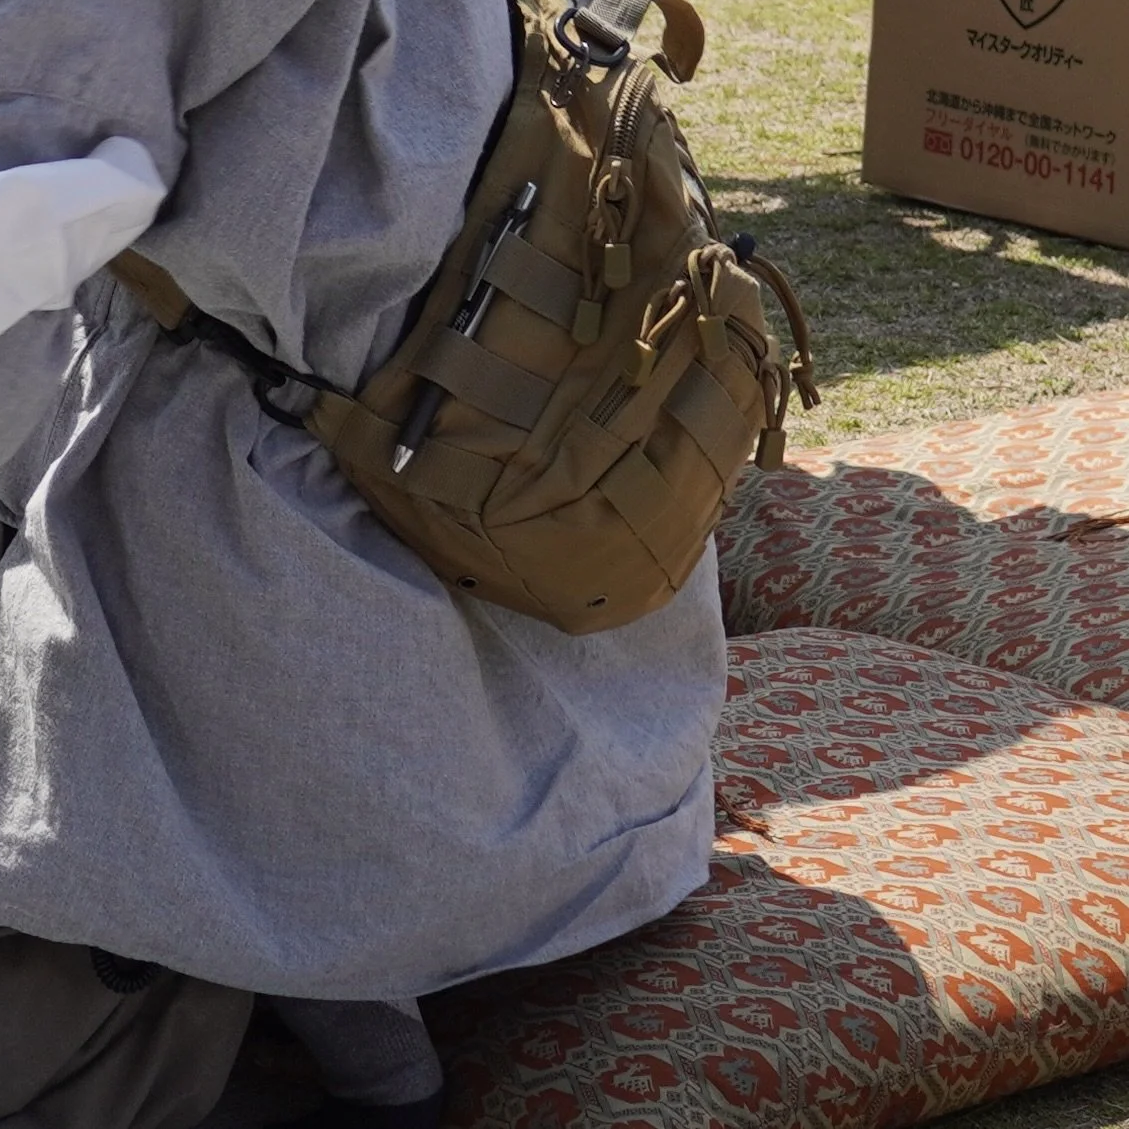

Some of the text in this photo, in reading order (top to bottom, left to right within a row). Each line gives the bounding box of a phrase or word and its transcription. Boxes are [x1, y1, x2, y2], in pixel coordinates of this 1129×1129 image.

[966, 28, 1084, 69] マイスタークオリティー
[924, 107, 1014, 141] フリーダイヤル
[960, 136, 1116, 195] 0120-00-1141
